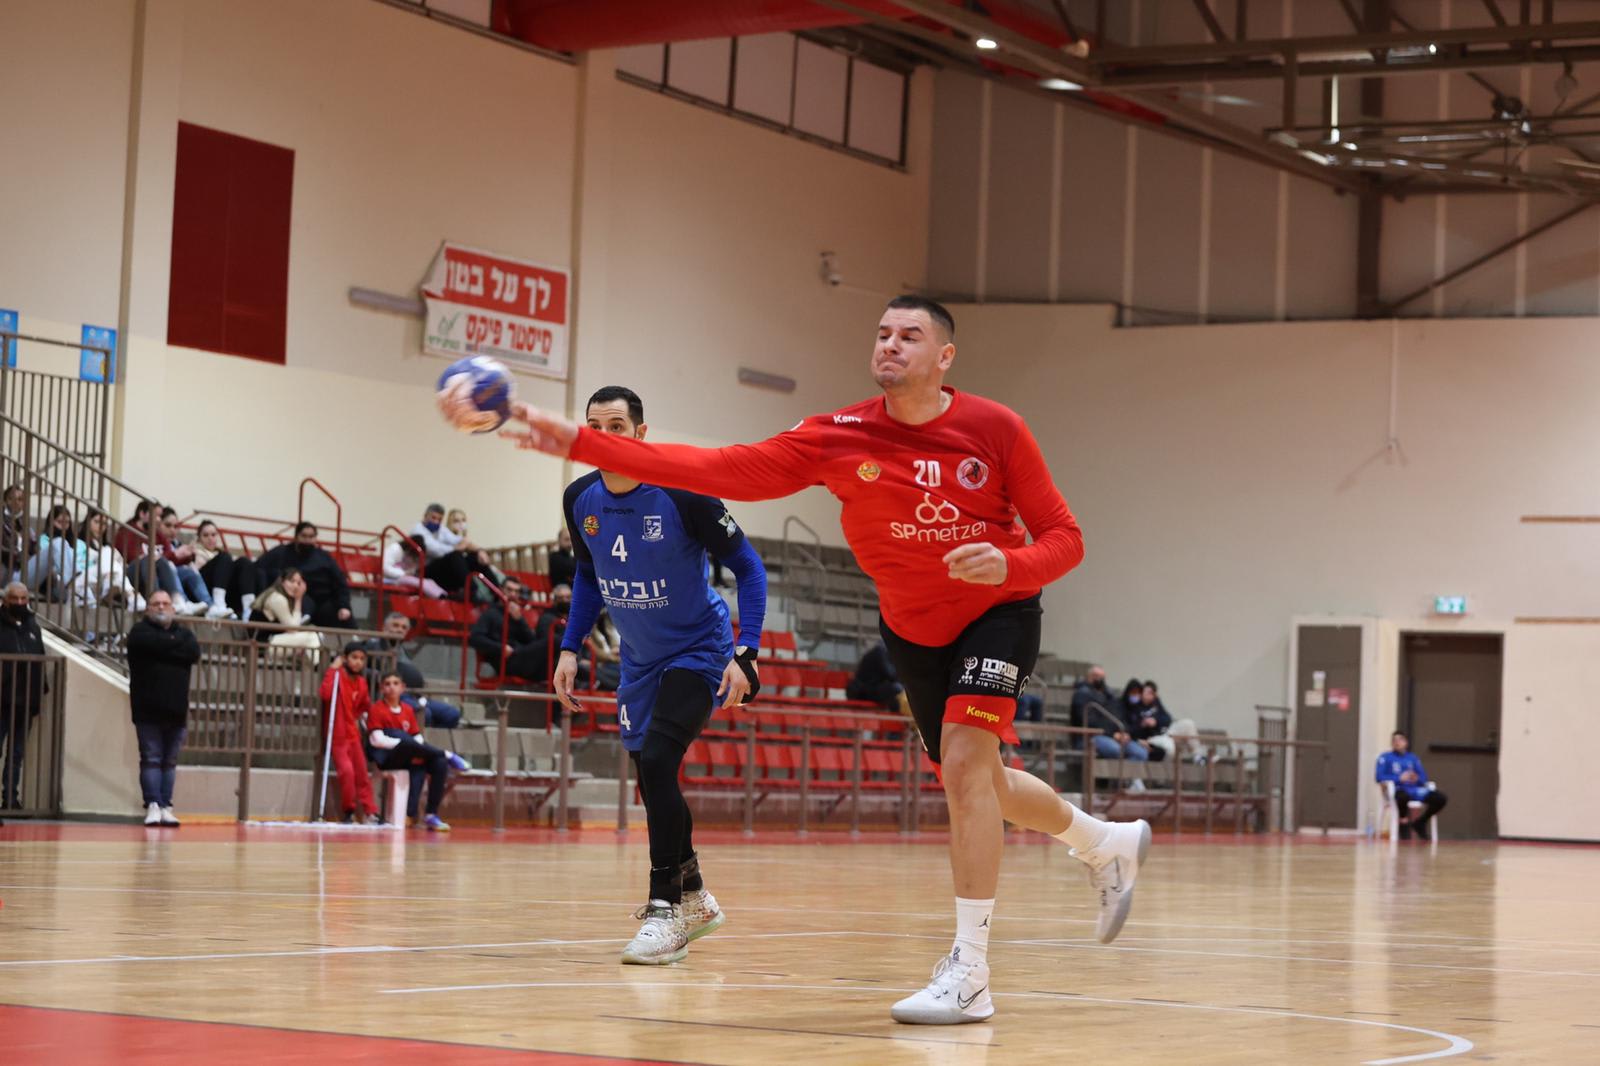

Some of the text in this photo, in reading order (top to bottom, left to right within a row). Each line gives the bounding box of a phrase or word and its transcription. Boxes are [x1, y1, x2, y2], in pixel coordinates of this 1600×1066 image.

[491, 267, 519, 303] על
[523, 276, 551, 316] לך
[465, 314, 502, 351] פיקס
[913, 459, 941, 488] 20
[611, 534, 628, 563] 4
[597, 576, 667, 599] יובלים
[620, 703, 632, 731] 4
